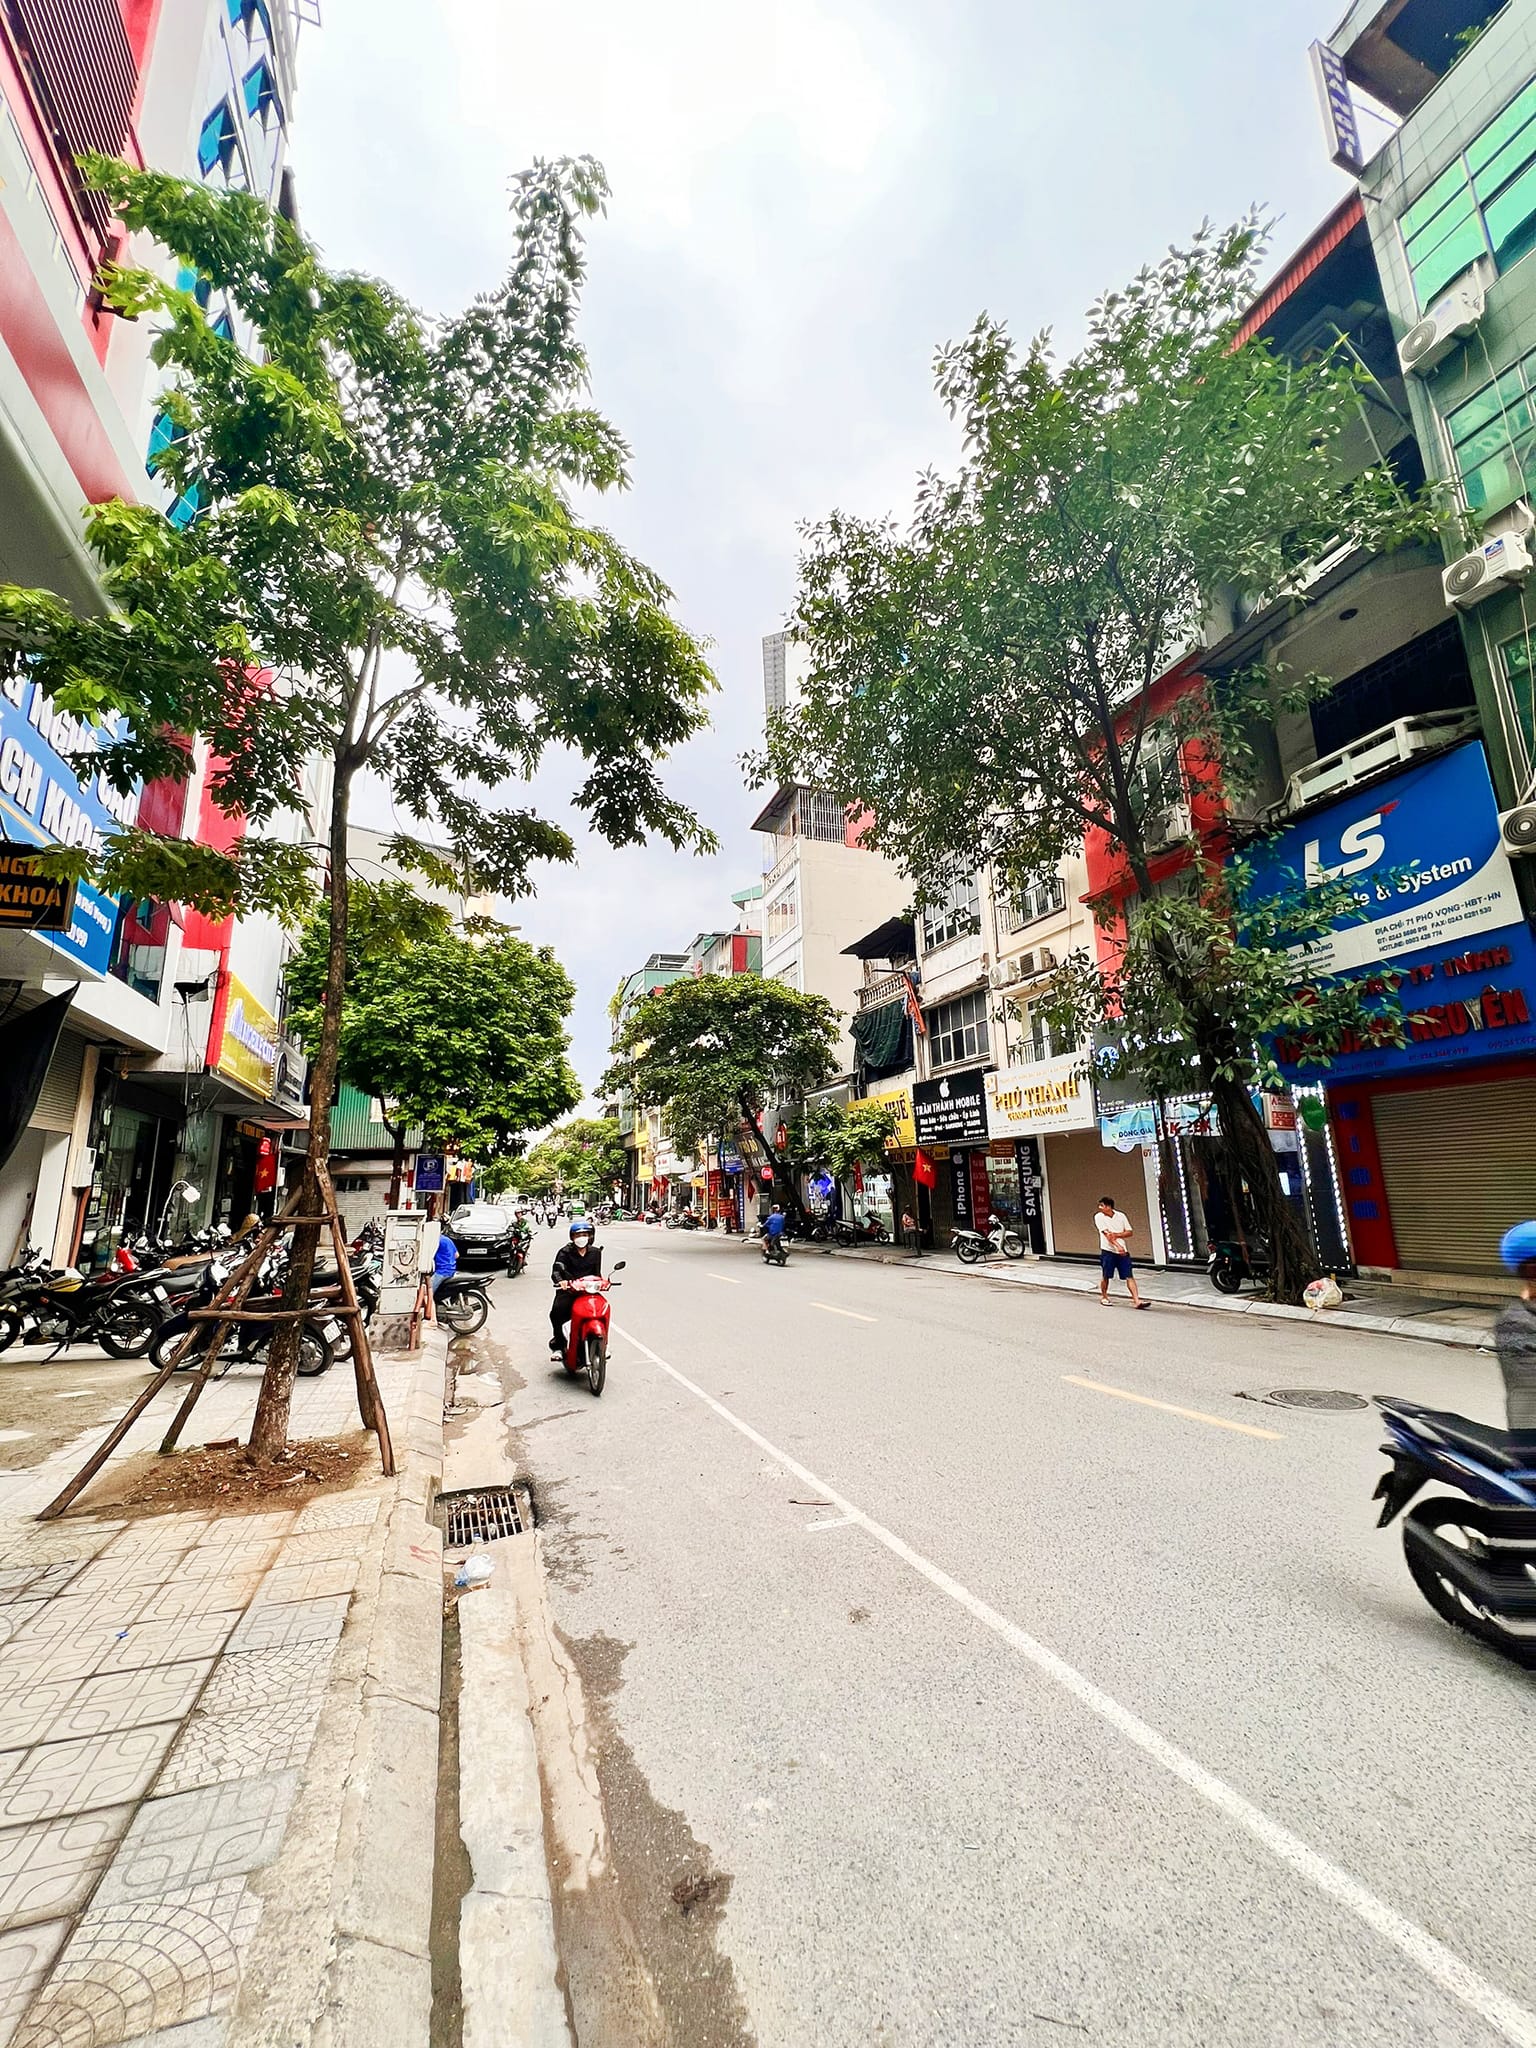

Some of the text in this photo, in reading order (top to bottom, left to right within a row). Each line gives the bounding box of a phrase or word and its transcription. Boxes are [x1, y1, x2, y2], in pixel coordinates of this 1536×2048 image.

[1304, 813, 1386, 889] LS
[1396, 856, 1473, 895] System
[956, 1171, 967, 1215] iPhone
[1020, 1146, 1036, 1217] SAMSUNG
